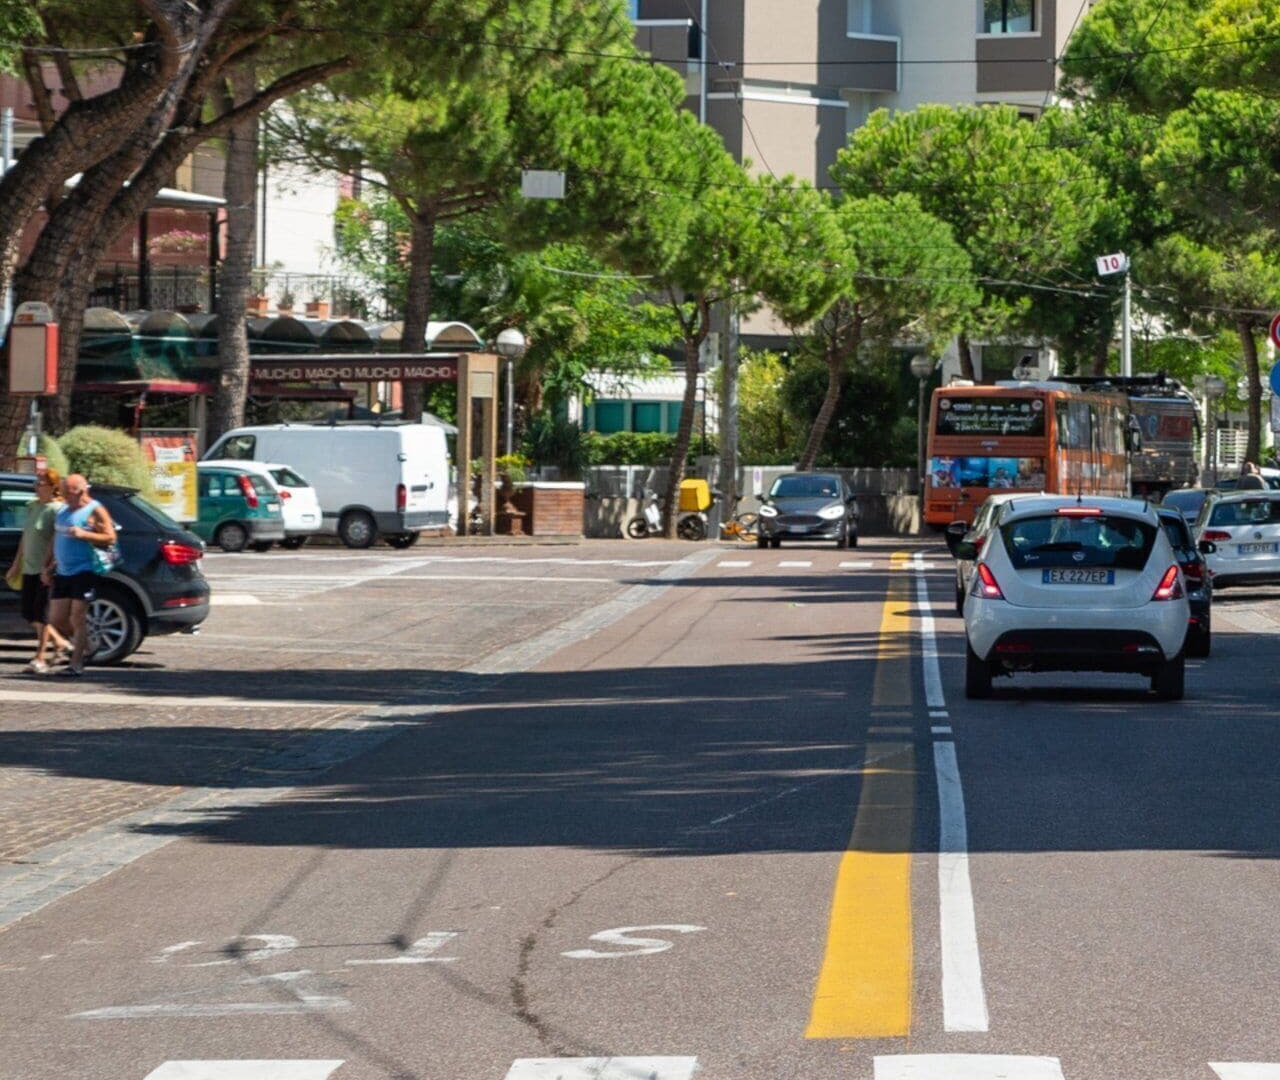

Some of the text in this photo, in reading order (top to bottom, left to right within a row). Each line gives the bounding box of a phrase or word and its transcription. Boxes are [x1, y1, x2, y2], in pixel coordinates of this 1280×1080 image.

[1103, 257, 1119, 271] 10
[255, 367, 450, 380] MUCHO MACHO MUCHO MACHO
[1051, 569, 1105, 582] EX 227EP
